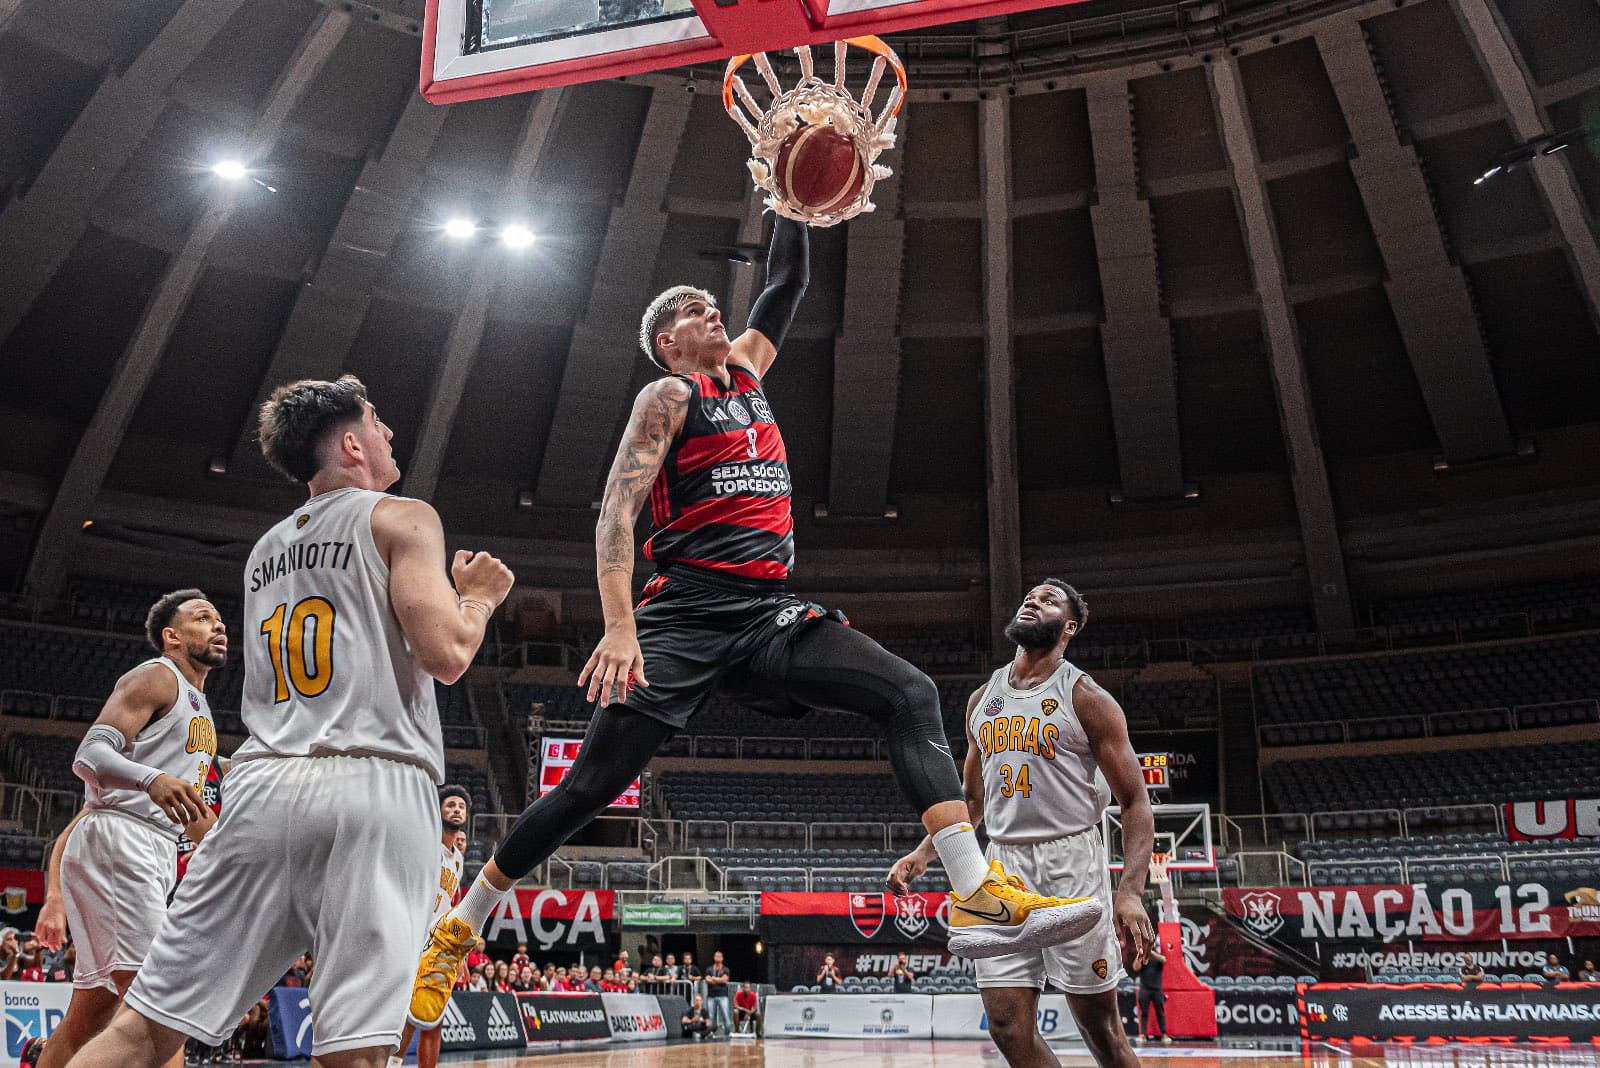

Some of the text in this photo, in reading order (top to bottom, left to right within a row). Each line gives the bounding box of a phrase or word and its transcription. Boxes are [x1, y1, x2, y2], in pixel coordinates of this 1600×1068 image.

[711, 464, 785, 480] SEJA SÓCIO
[712, 478, 788, 494] TORCEDOR
[250, 541, 354, 593] SMANIOTTI
[260, 595, 336, 705] 10
[979, 715, 1060, 760] OBRAS
[1000, 763, 1032, 799] 34
[1297, 883, 1551, 943] NAÇÃO 12
[4, 991, 39, 1006] banco
[1379, 1004, 1450, 1021] ACESSE
[1451, 1001, 1481, 1021] JÁ:
[441, 1021, 476, 1042] adidas
[487, 1021, 518, 1041] adidas
